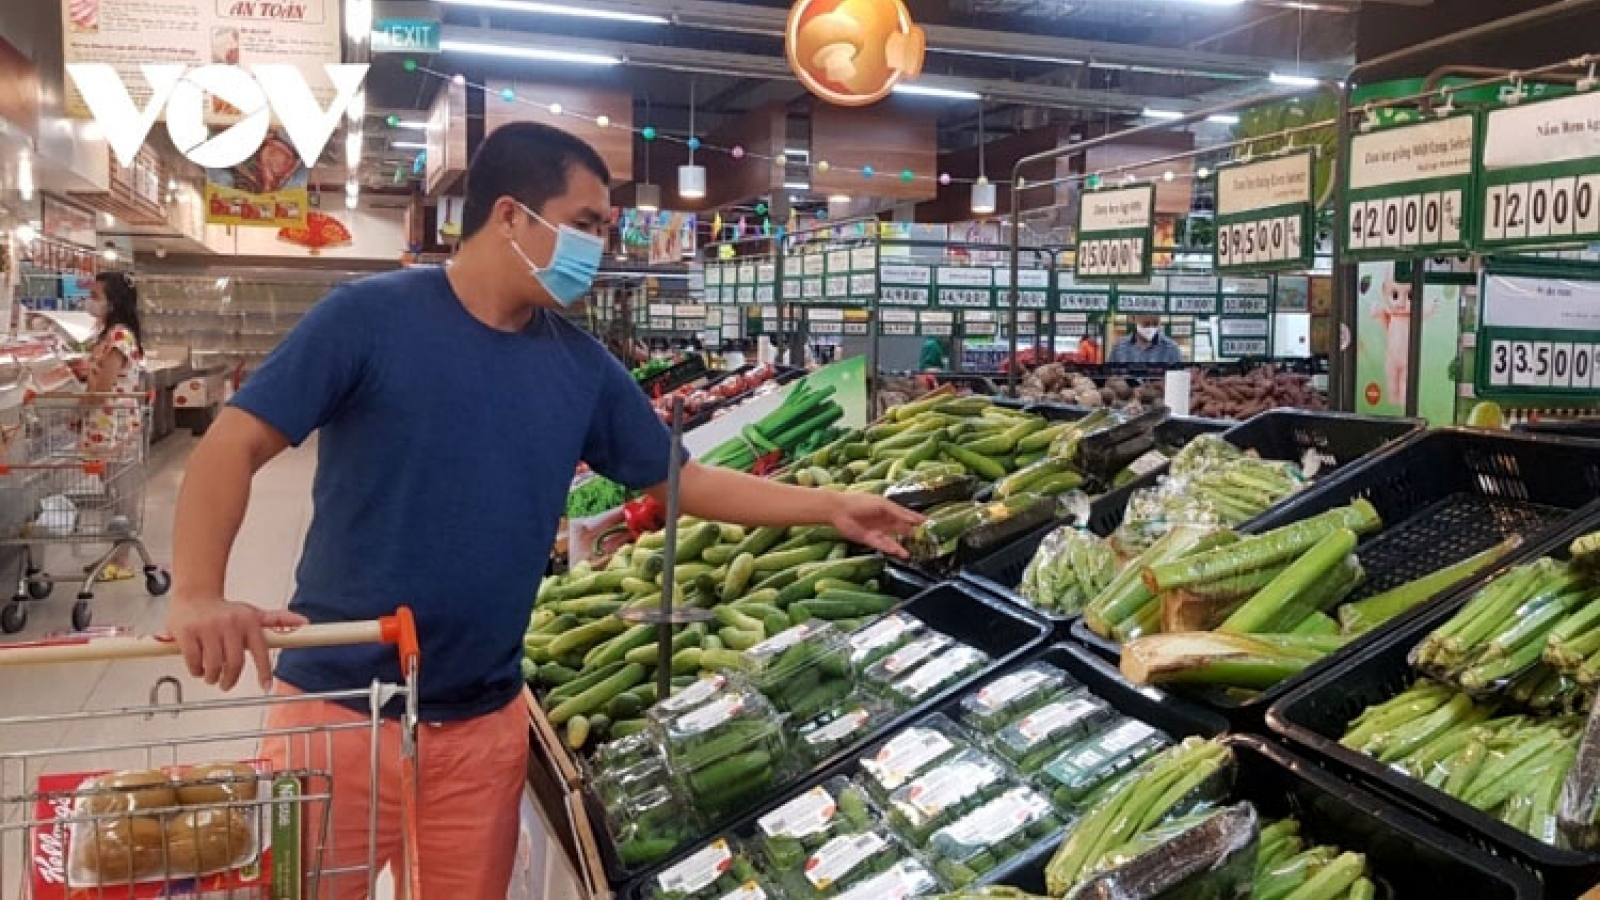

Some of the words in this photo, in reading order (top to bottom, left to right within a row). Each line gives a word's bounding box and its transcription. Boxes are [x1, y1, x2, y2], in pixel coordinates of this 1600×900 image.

[392, 26, 431, 47] EXIT
[1492, 182, 1592, 228] 12.000
[1494, 344, 1588, 378] 33.500
